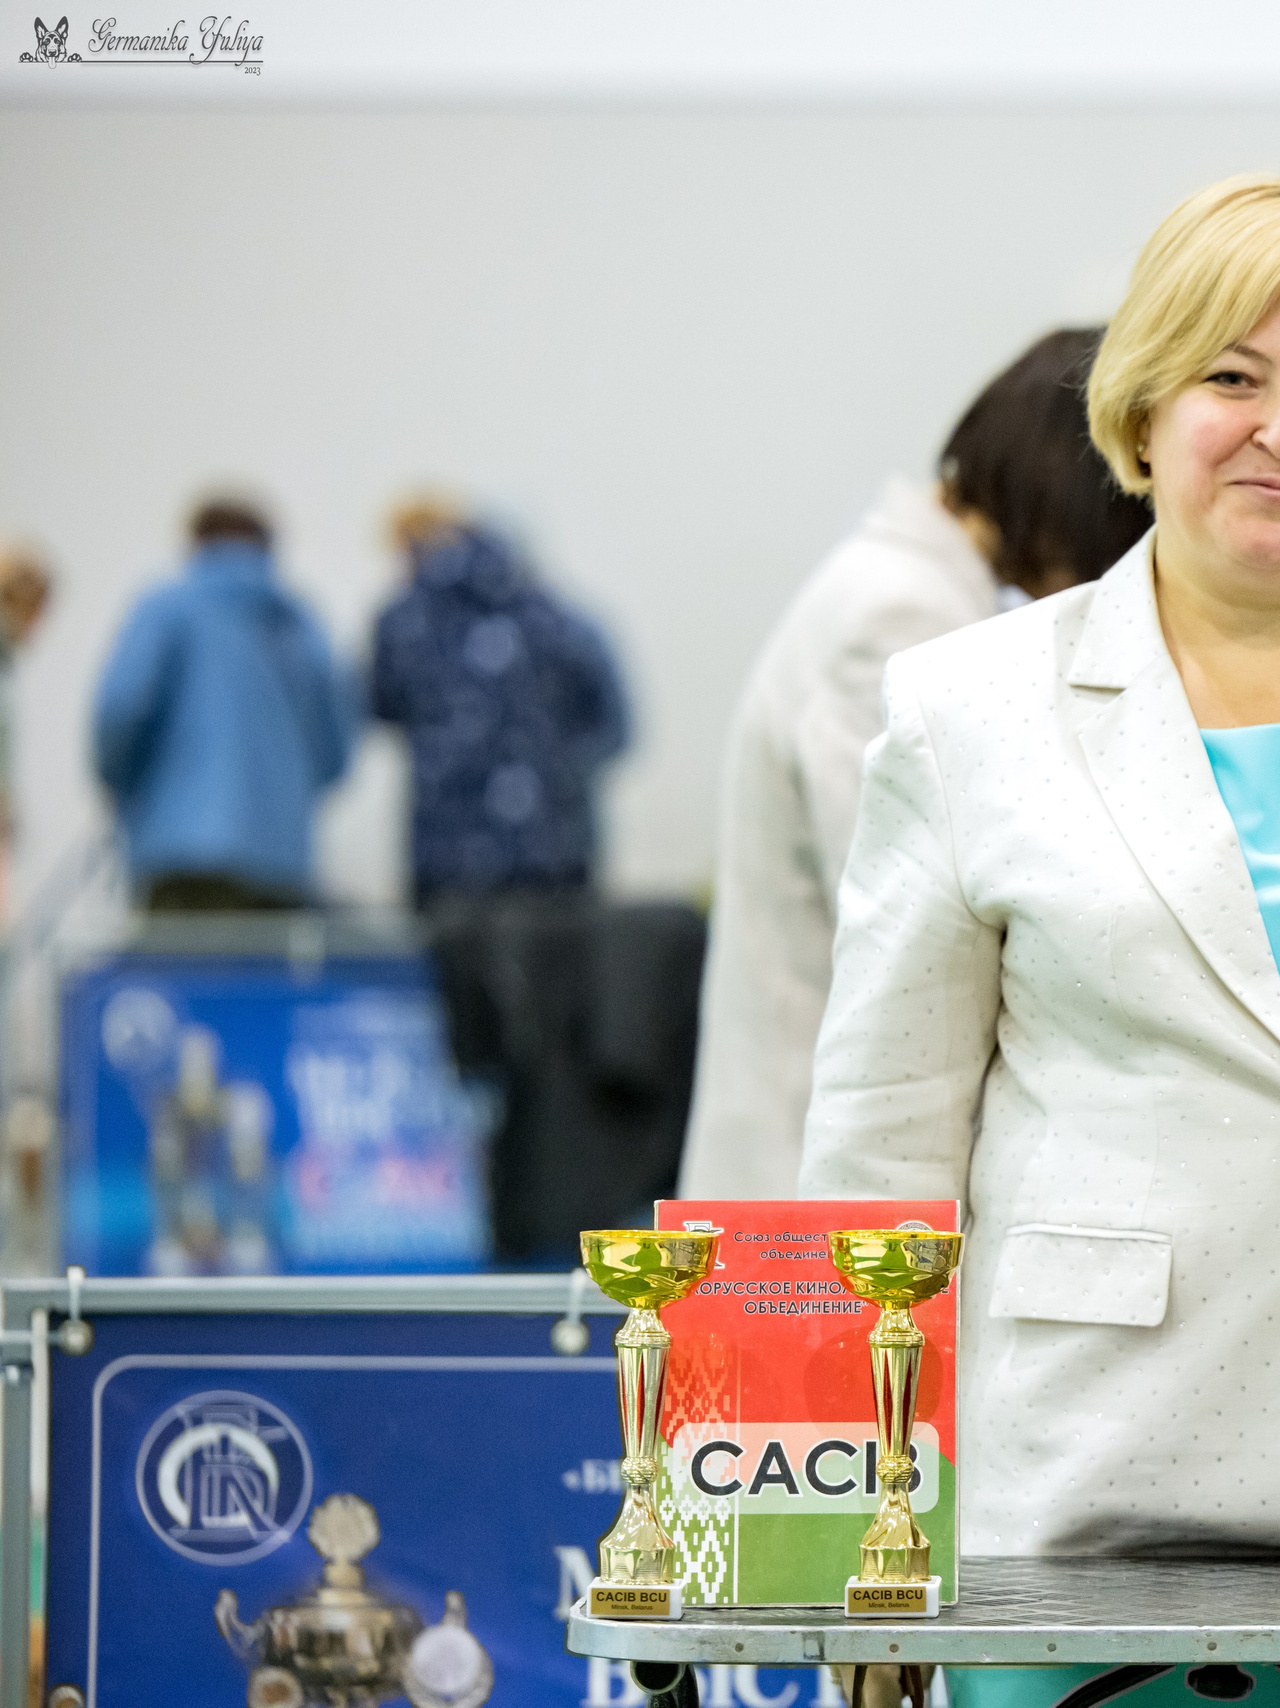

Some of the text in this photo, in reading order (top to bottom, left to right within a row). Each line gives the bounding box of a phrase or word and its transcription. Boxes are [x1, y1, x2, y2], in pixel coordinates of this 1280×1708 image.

[734, 1231, 828, 1243] Союз общест
[760, 1248, 830, 1260] объедине
[696, 1281, 791, 1295] ОРУССКОЕ
[596, 1591, 667, 1603] CACIB BCU
[853, 1589, 923, 1600] CACIB BCU
